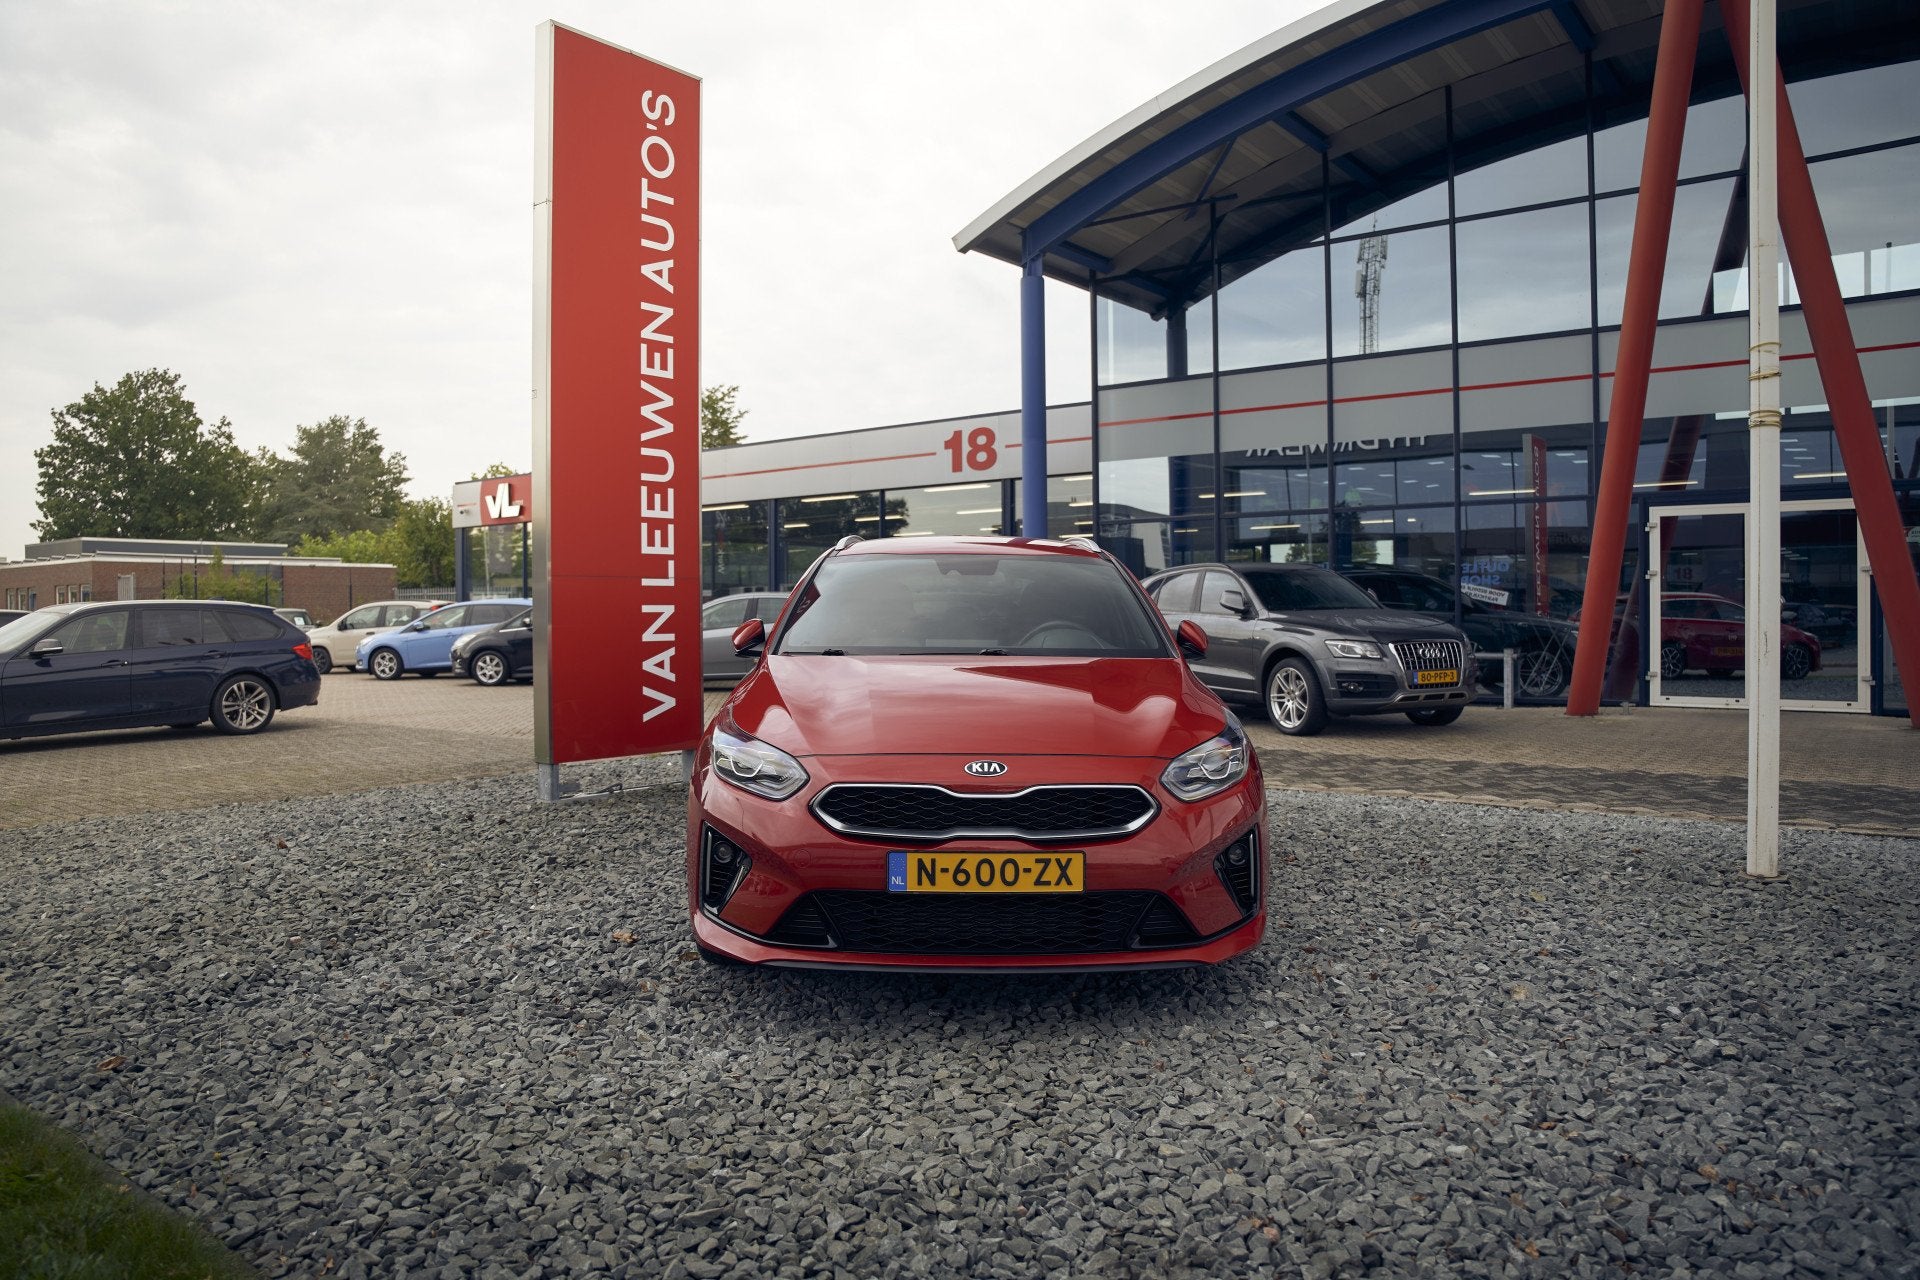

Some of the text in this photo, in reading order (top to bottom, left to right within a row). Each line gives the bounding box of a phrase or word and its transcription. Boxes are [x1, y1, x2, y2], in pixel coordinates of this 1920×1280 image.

[640, 89, 677, 722] VAN LEEUWEN AUTO'S
[943, 427, 998, 473] 18
[1420, 671, 1455, 683] 80-PFP-3
[971, 762, 1001, 773] KIA
[891, 857, 1073, 887] NL N-600-ZX
